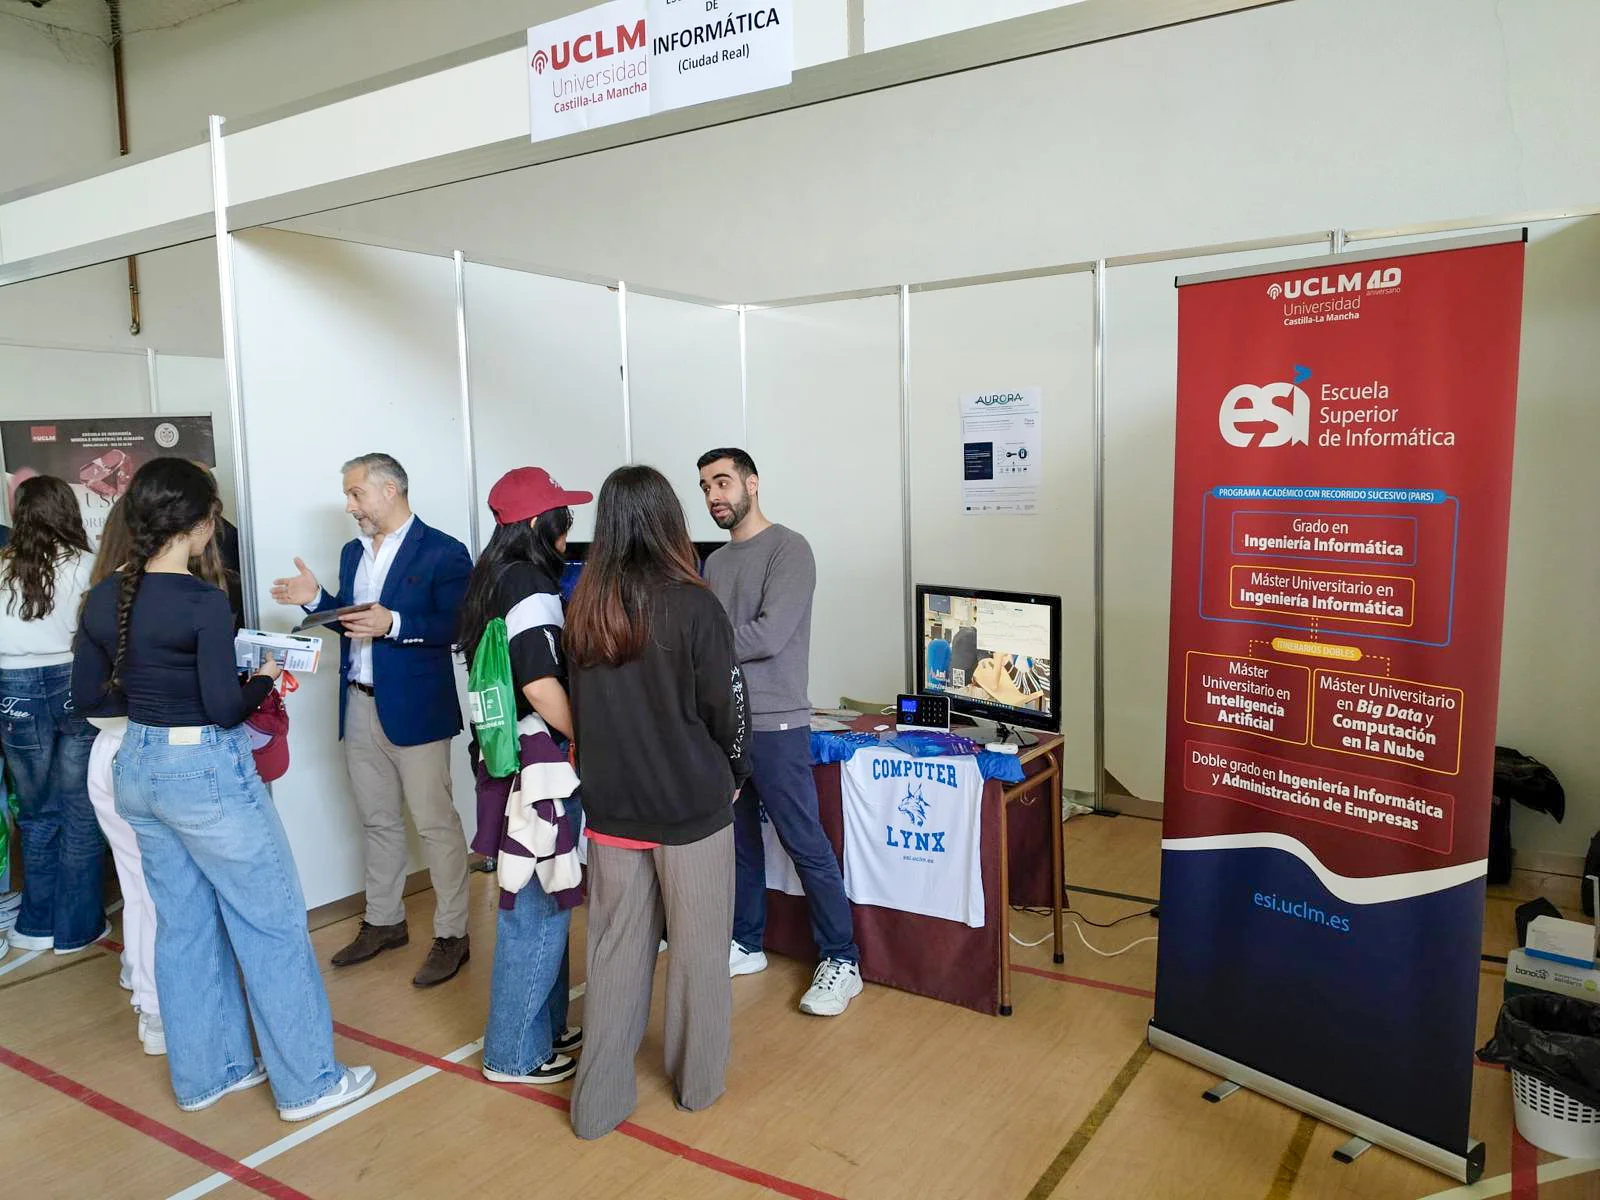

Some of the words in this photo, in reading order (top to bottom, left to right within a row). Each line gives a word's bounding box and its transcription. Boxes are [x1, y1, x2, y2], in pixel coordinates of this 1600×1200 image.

[550, 19, 646, 71] UCLM
[653, 8, 780, 56] INFORMÁTICA
[678, 48, 719, 74] (Ciudad
[722, 43, 750, 61] Real)
[552, 54, 647, 99] Universidad
[554, 93, 604, 114] Castilla-La
[606, 81, 647, 102] Mancha
[1284, 272, 1362, 299] UCLM
[1284, 295, 1360, 316] Universidad
[1284, 314, 1325, 326] Castilla-La
[1326, 311, 1360, 322] Mancha
[975, 393, 1024, 406] AURORA
[1321, 382, 1389, 401] Escuela
[1320, 406, 1399, 427] Superior
[1318, 428, 1341, 447] de
[1346, 427, 1455, 447] Informática
[1219, 488, 1261, 497] PROGRAMA
[1262, 487, 1303, 498] ACADÉMICO
[1304, 489, 1320, 499] CON
[1321, 489, 1366, 500] RECORRIDO
[1367, 490, 1407, 501] SUCESIVO
[1408, 491, 1434, 502] (PARS)
[1292, 518, 1329, 534] Grado
[1332, 522, 1349, 535] en
[1244, 534, 1311, 551] Ingeniería
[1314, 537, 1403, 557] Informática
[1251, 572, 1290, 589] Máster
[1292, 576, 1373, 597] Universitario
[1376, 585, 1394, 597] en
[1240, 588, 1309, 609] Ingeniería
[1312, 597, 1404, 618] Informática
[1229, 661, 1269, 679] Máster
[1202, 675, 1274, 697] Universitario
[1276, 688, 1291, 701] en
[1320, 676, 1365, 696] Máster
[1368, 682, 1456, 710] Universitario
[1207, 692, 1285, 717] Inteligencia
[1337, 699, 1354, 712] en
[1356, 699, 1382, 719] Big
[1385, 703, 1423, 724] Data
[1425, 713, 1434, 728] y
[1218, 709, 1274, 732] Artificial
[1332, 714, 1436, 745] Computación
[1342, 735, 1362, 749] en
[1365, 736, 1380, 752] la
[1384, 739, 1425, 762] Nube
[872, 758, 958, 788] COMPUTER
[1192, 751, 1227, 769] Doble
[1230, 758, 1261, 779] grado
[1262, 768, 1276, 782] en
[1278, 770, 1350, 797] Ingeniería
[1353, 785, 1443, 820] Informática
[1211, 772, 1220, 786] y
[1222, 772, 1320, 809] Administración
[1323, 795, 1342, 813] de
[1345, 802, 1419, 831] Empresas
[886, 825, 945, 853] LYNX
[1254, 890, 1350, 932] esi.uclm.es
